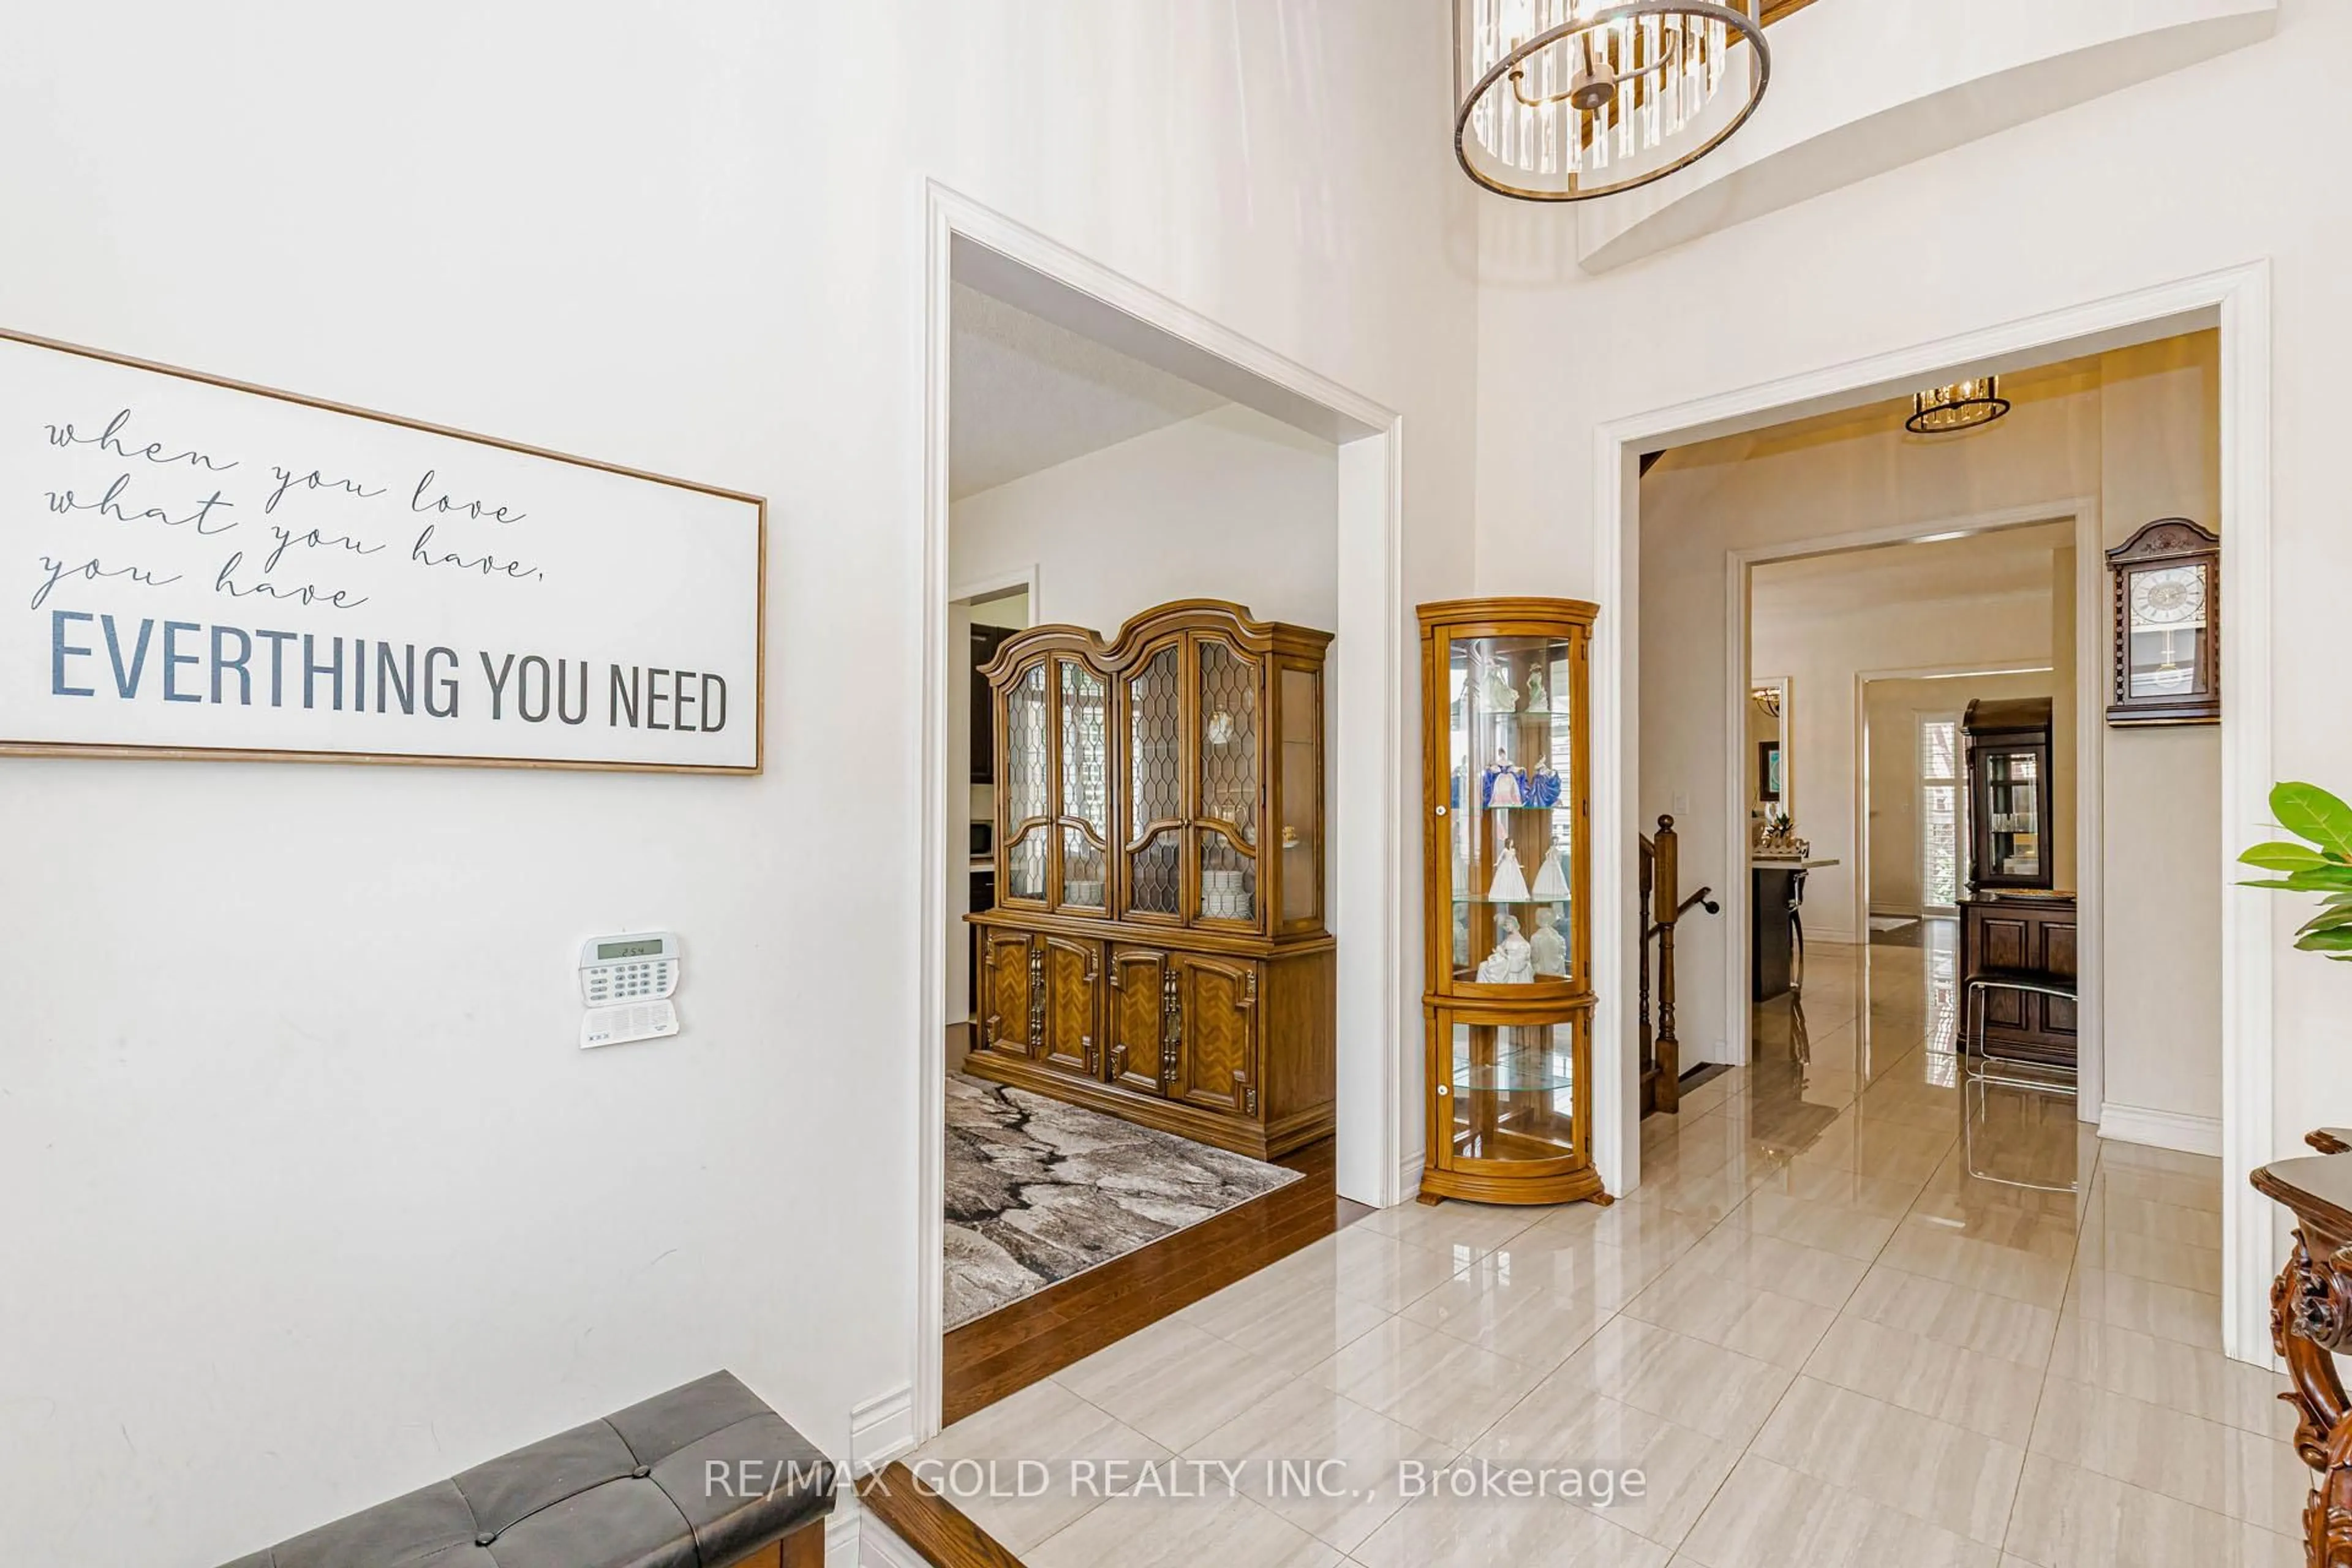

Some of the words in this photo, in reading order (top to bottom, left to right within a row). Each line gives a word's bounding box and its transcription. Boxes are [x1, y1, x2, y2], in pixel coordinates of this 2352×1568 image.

[44, 409, 239, 470] when
[265, 467, 387, 514] you
[411, 470, 527, 524] love
[44, 473, 238, 535] what
[264, 526, 386, 574] you
[31, 556, 183, 610] you
[215, 551, 369, 609] have
[51, 609, 459, 719] EVERTHING
[479, 650, 588, 725] YOU
[609, 663, 727, 733] NEED
